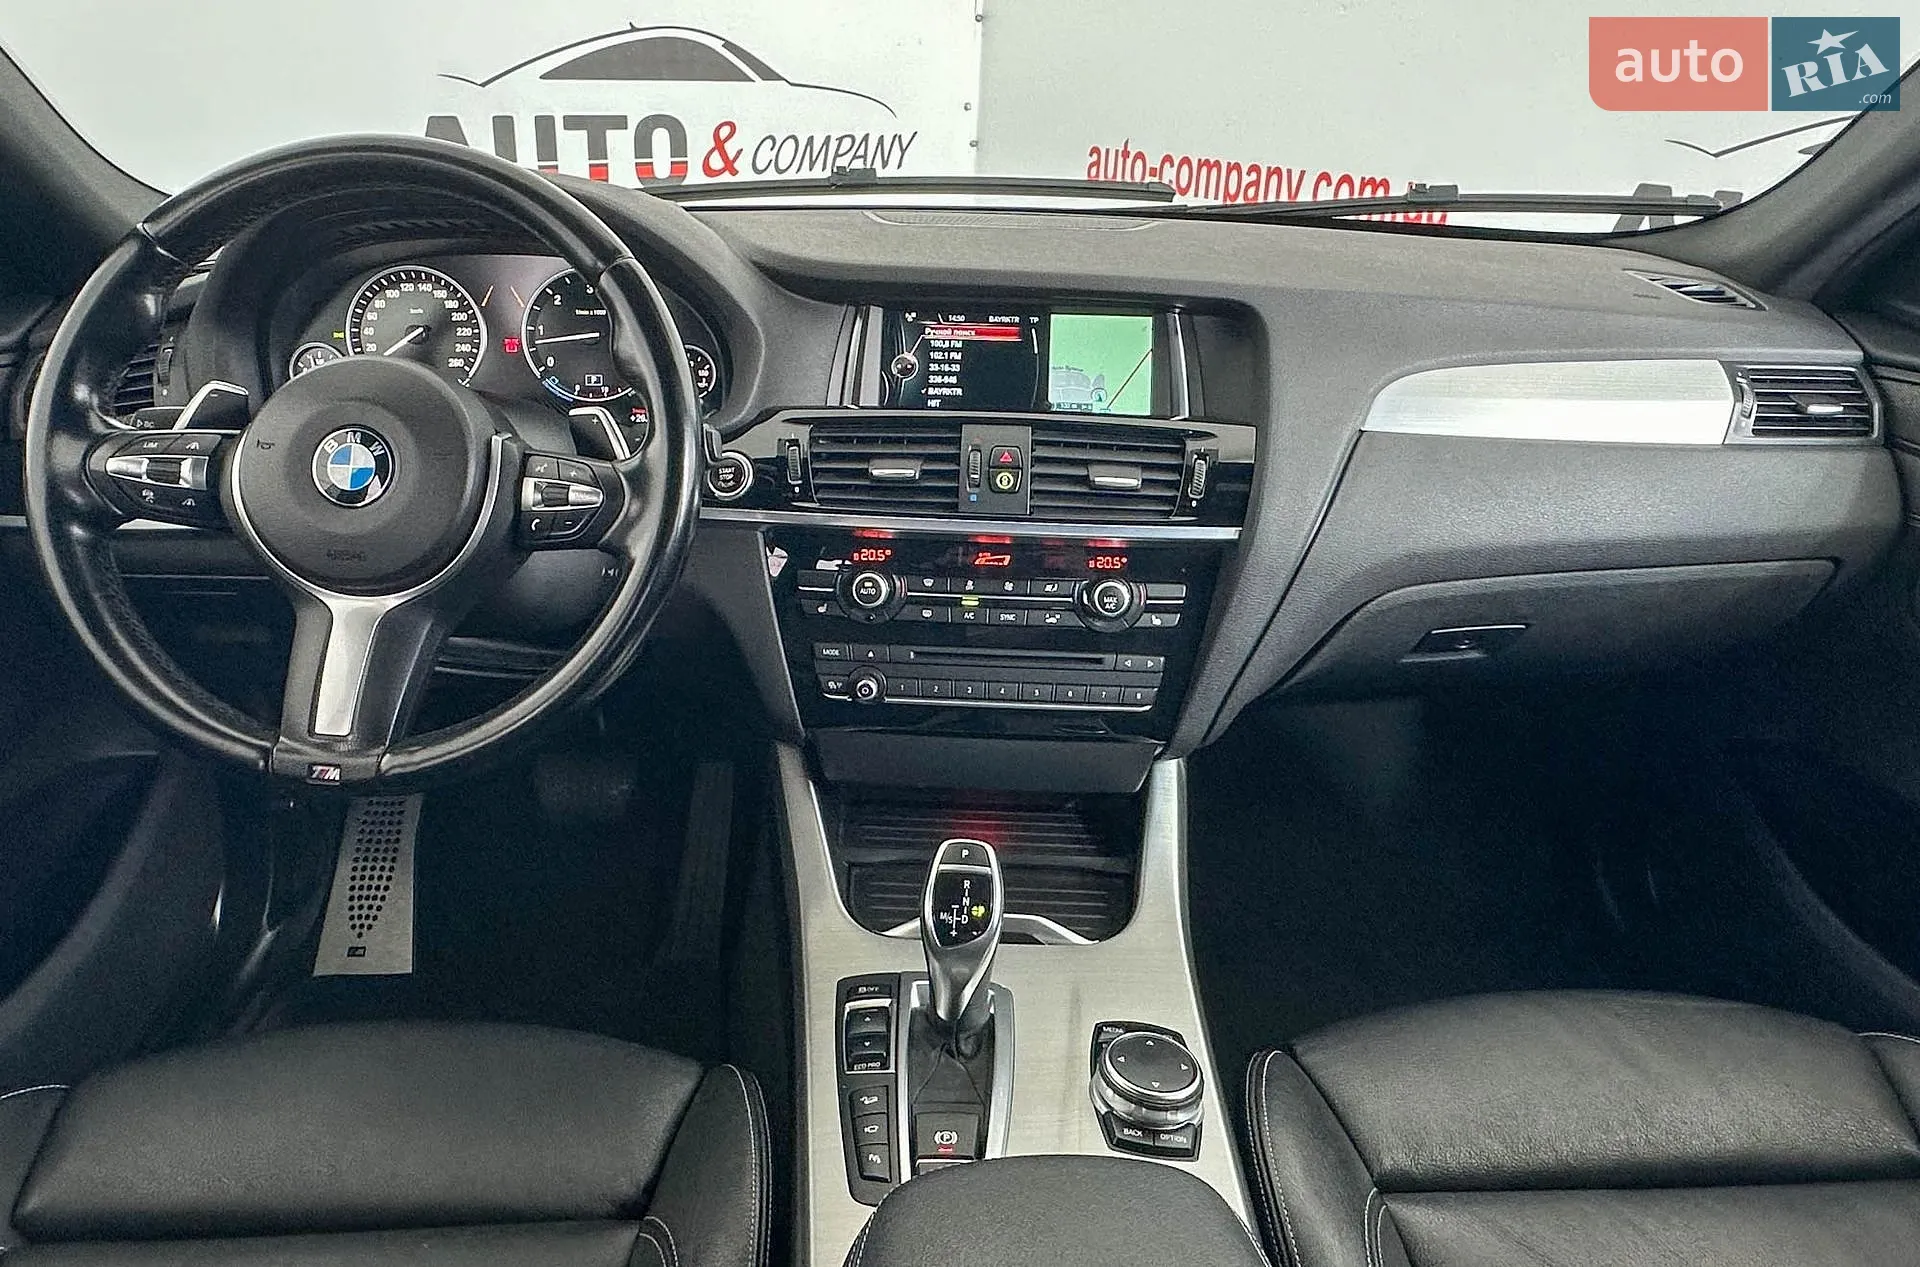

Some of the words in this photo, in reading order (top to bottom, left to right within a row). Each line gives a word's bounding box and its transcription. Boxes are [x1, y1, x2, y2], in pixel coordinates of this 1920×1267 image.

[702, 121, 745, 178] &
[751, 131, 917, 176] COMPANY
[400, 282, 414, 291] 120
[417, 282, 432, 292] 140
[385, 289, 400, 298] 100
[554, 294, 562, 305] 2
[451, 311, 468, 321] 200
[1029, 316, 1039, 324] TP
[363, 326, 375, 336] 40
[456, 327, 472, 336] 220
[538, 325, 544, 335] 1
[365, 343, 377, 352] 20
[454, 343, 472, 353] 240
[950, 340, 963, 348] FM
[950, 351, 962, 360] FM
[546, 357, 555, 367] 0
[324, 431, 385, 456] BMW
[860, 588, 876, 596] AUTO
[1103, 596, 1118, 604] MAX
[963, 612, 975, 620] A/C
[999, 613, 1016, 621] SYNC
[822, 648, 840, 656] MODE
[961, 849, 970, 858] P
[963, 880, 971, 889] R
[962, 897, 970, 906] N
[961, 914, 969, 924] D
[1102, 1026, 1125, 1034] MEDIA
[853, 1062, 867, 1071] ECO
[867, 1061, 881, 1069] PRO
[1123, 1127, 1143, 1138] BACK
[1159, 1133, 1187, 1144] OPTION
